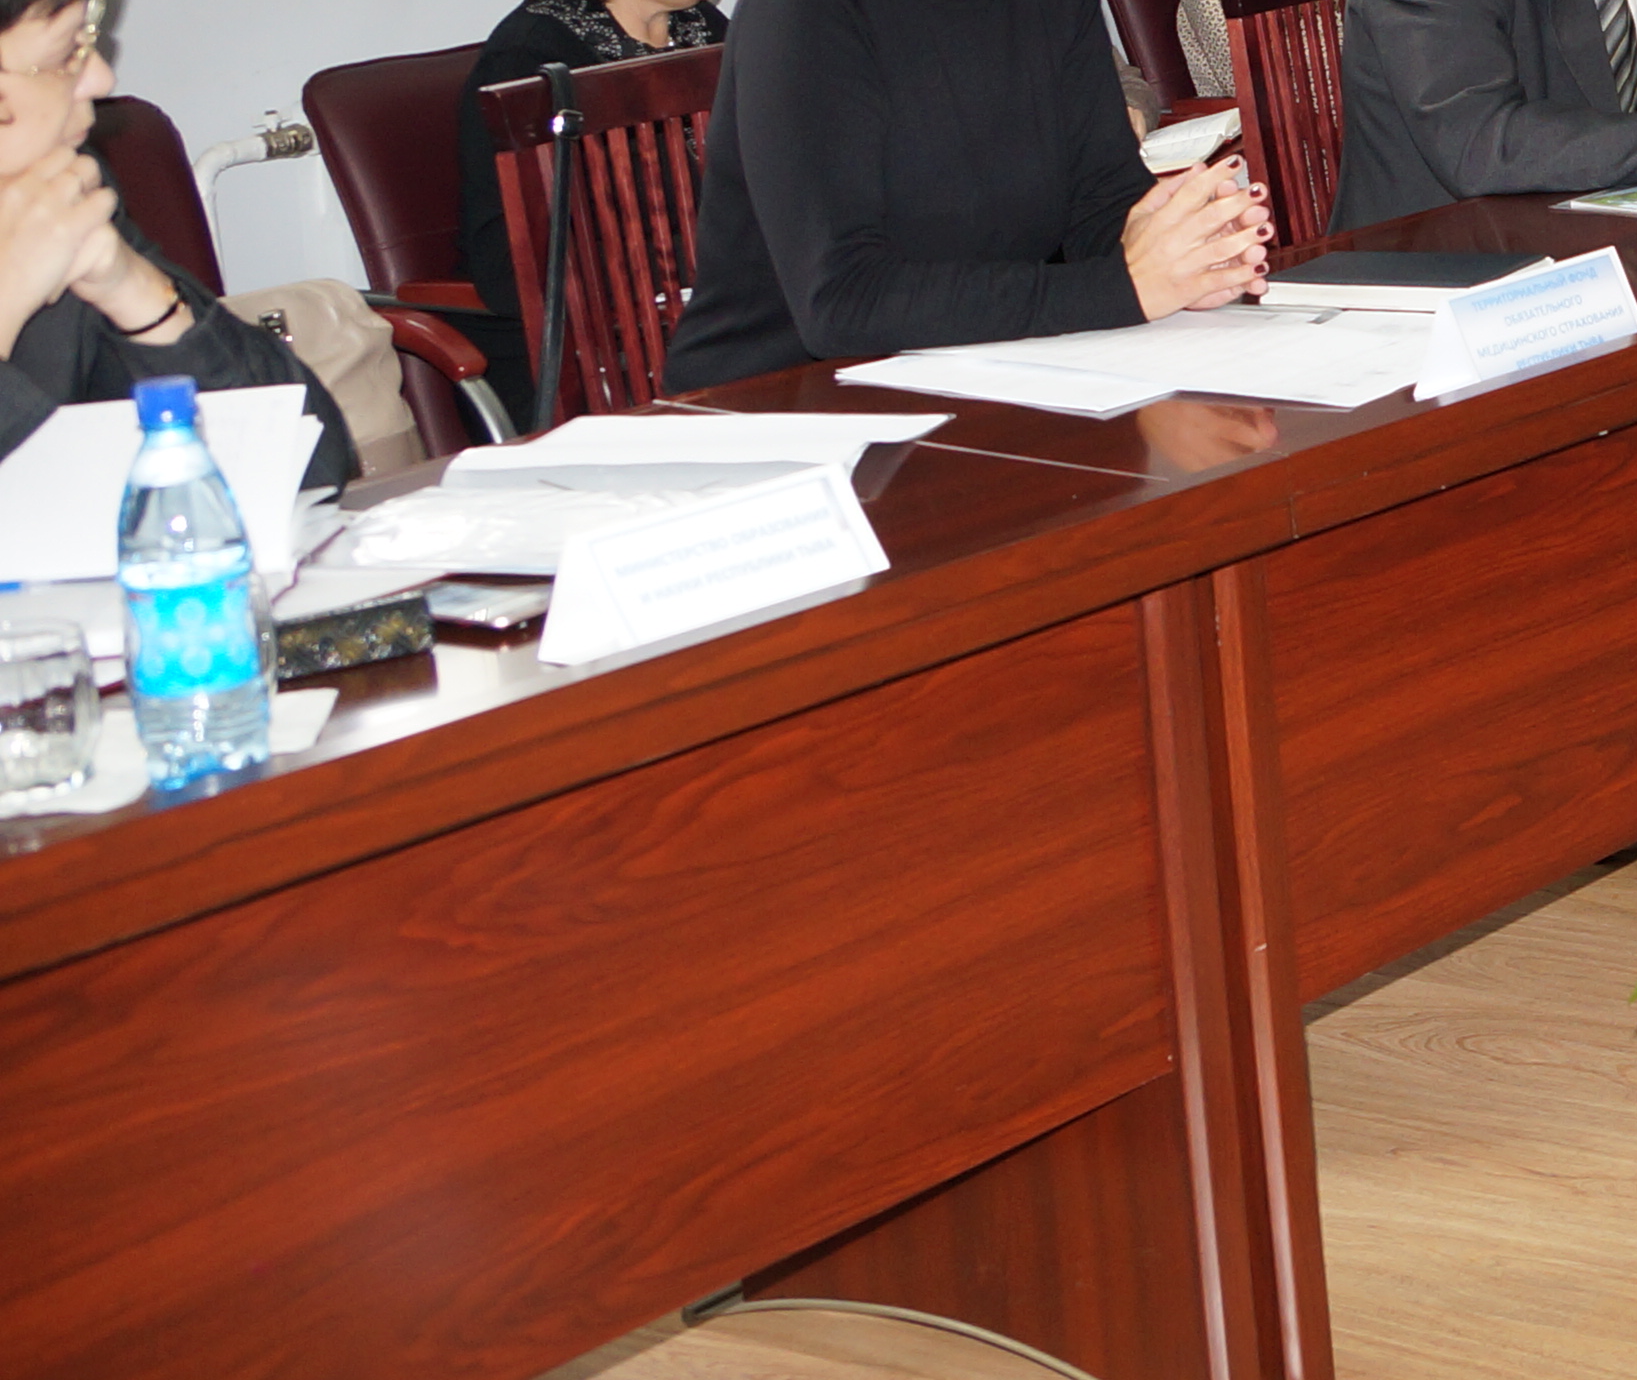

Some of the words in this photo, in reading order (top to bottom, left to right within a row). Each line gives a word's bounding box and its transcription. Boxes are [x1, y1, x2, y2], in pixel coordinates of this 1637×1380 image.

[1471, 273, 1567, 311] ТЕРРИТОРИАЛЬНЫЙ
[1568, 266, 1598, 284] ФОНД
[1504, 294, 1583, 325] ОБЯЗАТЕЛЬНОГО
[1477, 325, 1558, 359] МЕДИЦИНСКОГО
[1559, 305, 1624, 332] СТРАХОВАНИЯ
